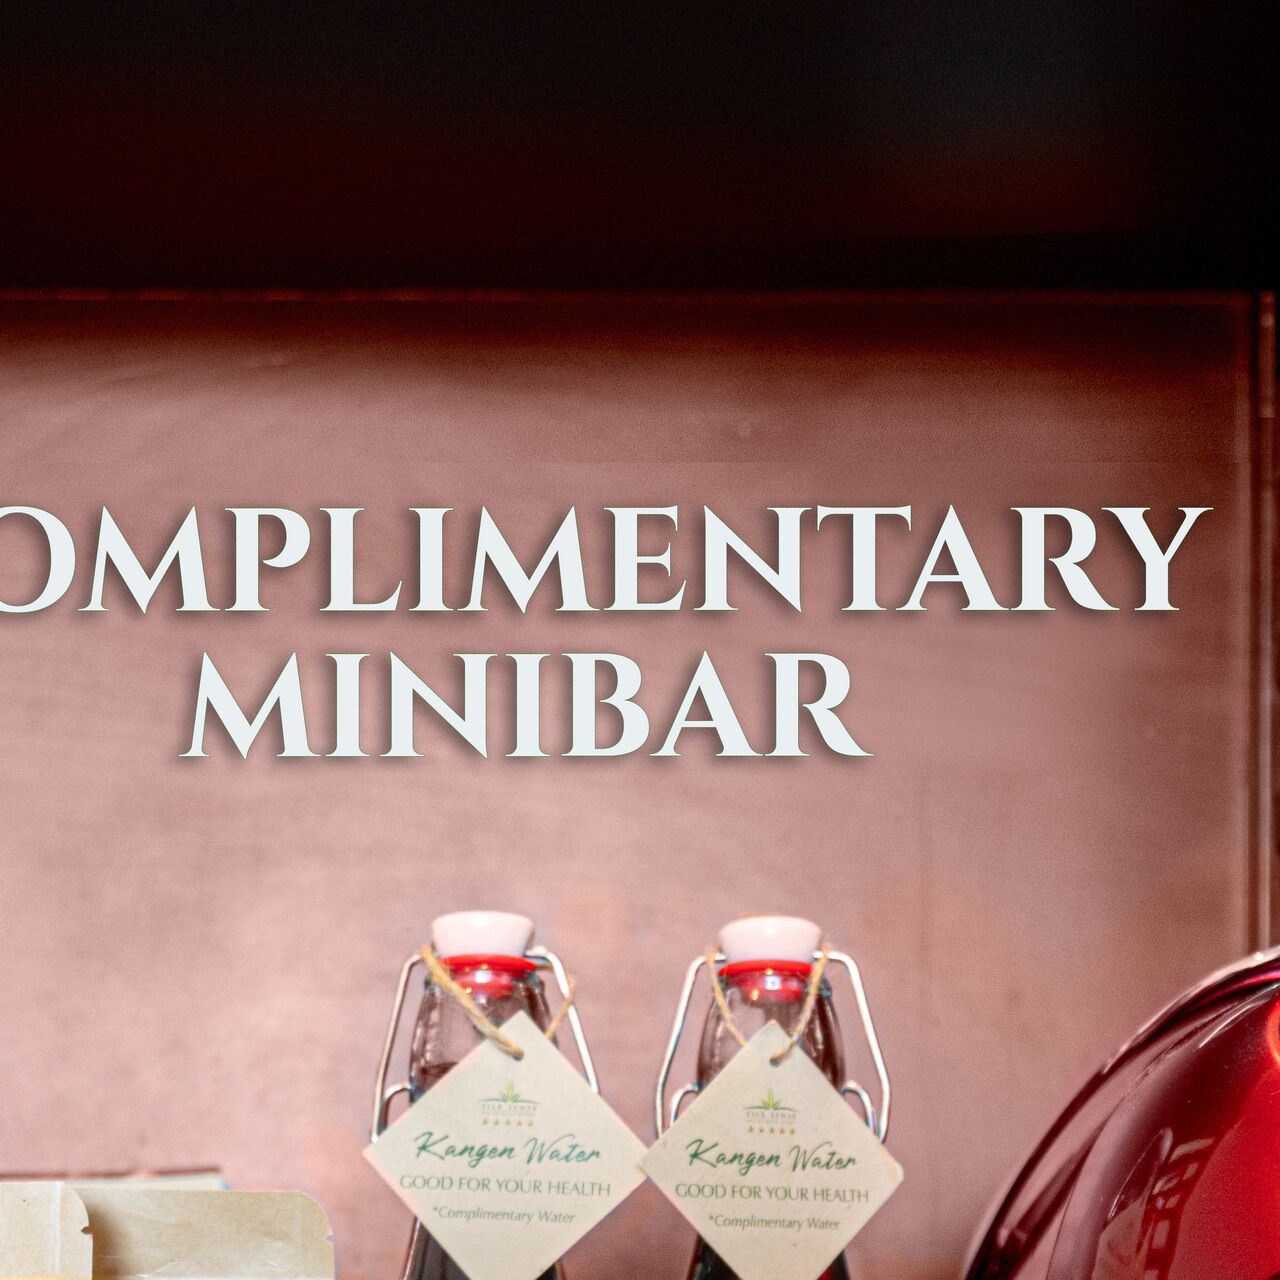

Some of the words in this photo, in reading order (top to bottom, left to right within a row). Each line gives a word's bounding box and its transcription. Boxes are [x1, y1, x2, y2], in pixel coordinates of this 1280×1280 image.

[414, 1131, 516, 1168] Kangen
[523, 1134, 601, 1165] Water
[685, 1139, 782, 1176] Kangen
[788, 1141, 858, 1171] Water
[400, 1175, 453, 1190] GOOD
[458, 1177, 491, 1191] FOR
[496, 1178, 542, 1194] YOUR
[548, 1181, 611, 1197] HEALTH
[675, 1183, 727, 1198] GOOD
[731, 1184, 761, 1198] FOR
[766, 1186, 808, 1201] YOUR
[813, 1188, 869, 1203] HEALTH
[537, 1210, 577, 1224] Water
[807, 1217, 840, 1230] Water
